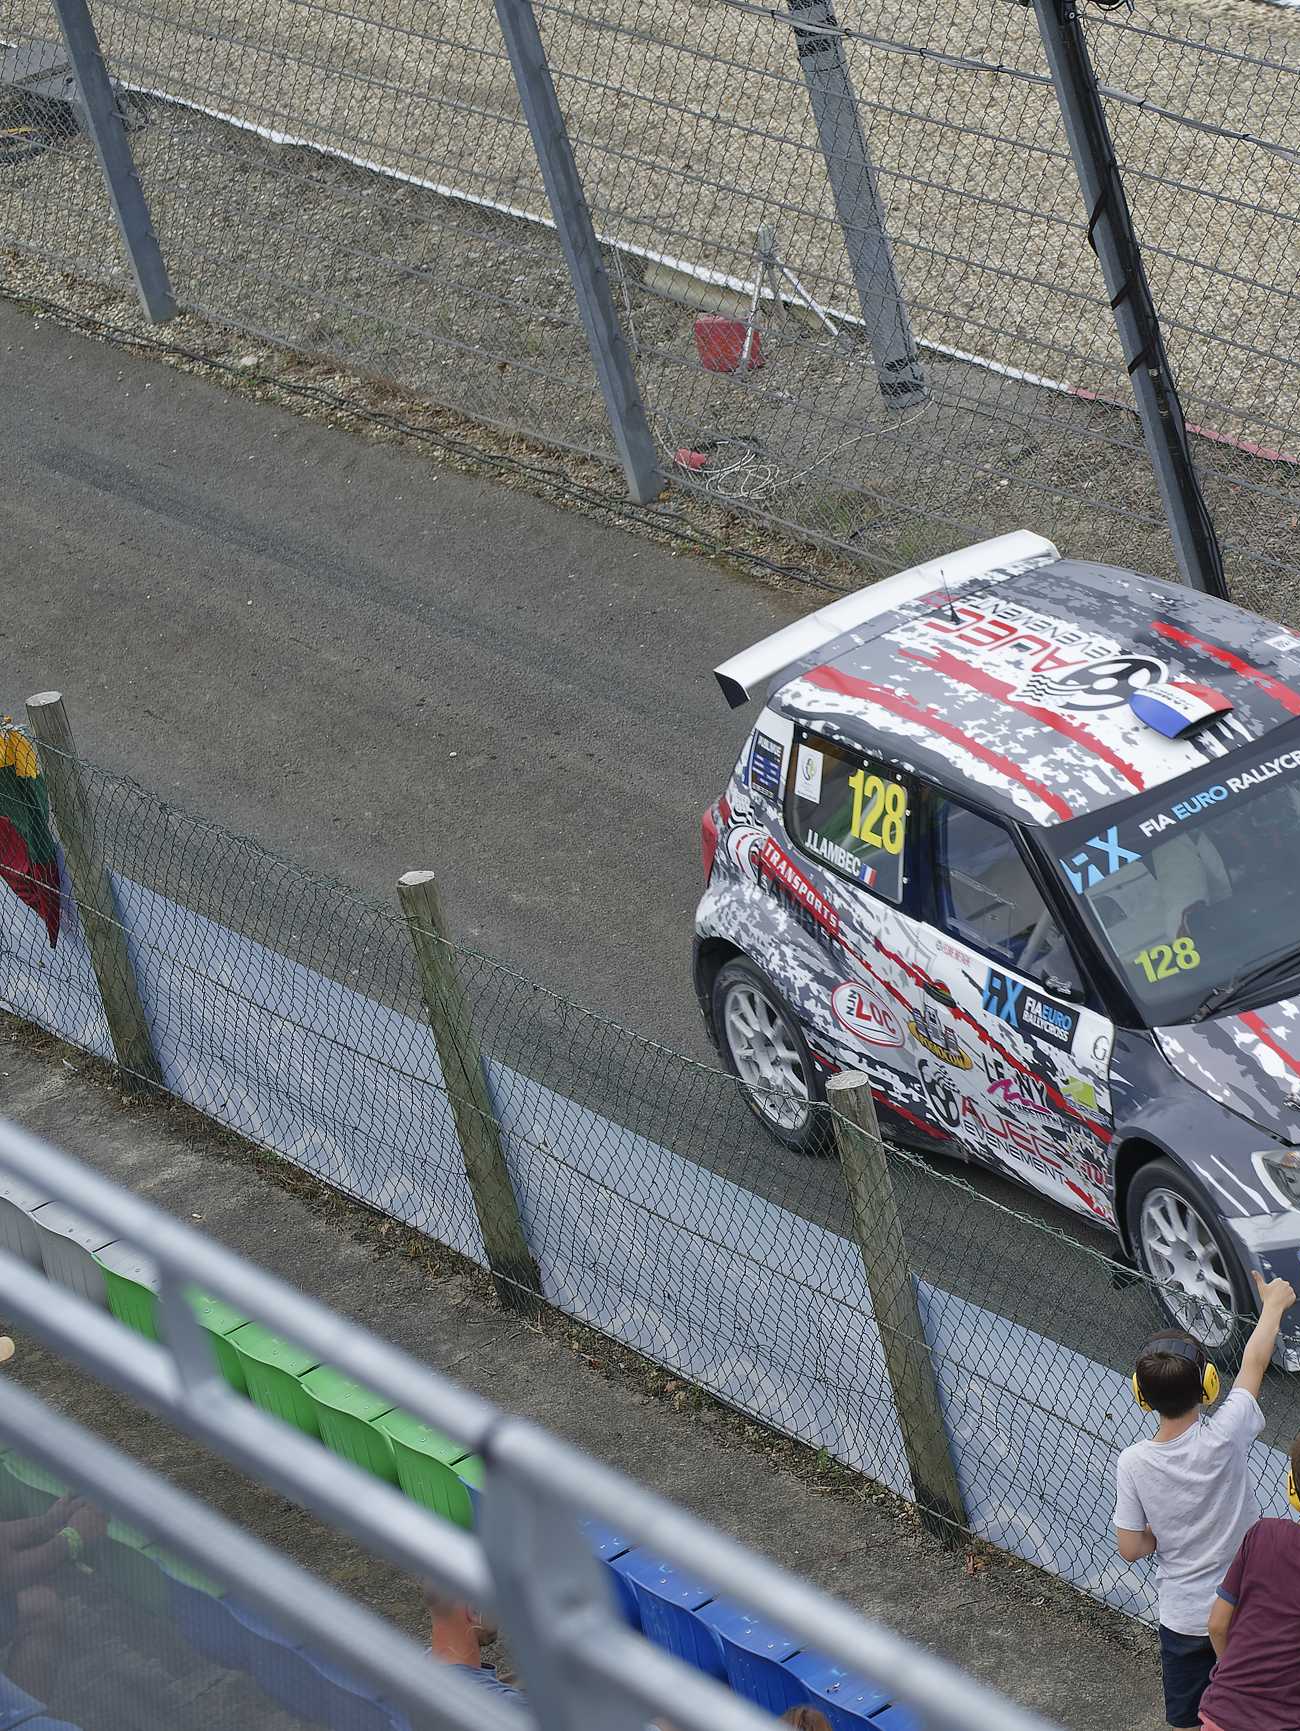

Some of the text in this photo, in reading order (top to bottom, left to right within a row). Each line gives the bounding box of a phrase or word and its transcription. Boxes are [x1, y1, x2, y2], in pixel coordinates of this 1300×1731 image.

[849, 769, 905, 855] 128
[1139, 812, 1176, 838] FIA
[1171, 784, 1228, 821] EURO
[764, 842, 839, 928] TRANSPORTS
[1134, 937, 1201, 984] 128
[856, 993, 896, 1035] LOC
[1023, 1010, 1069, 1042] RALLYCROSS
